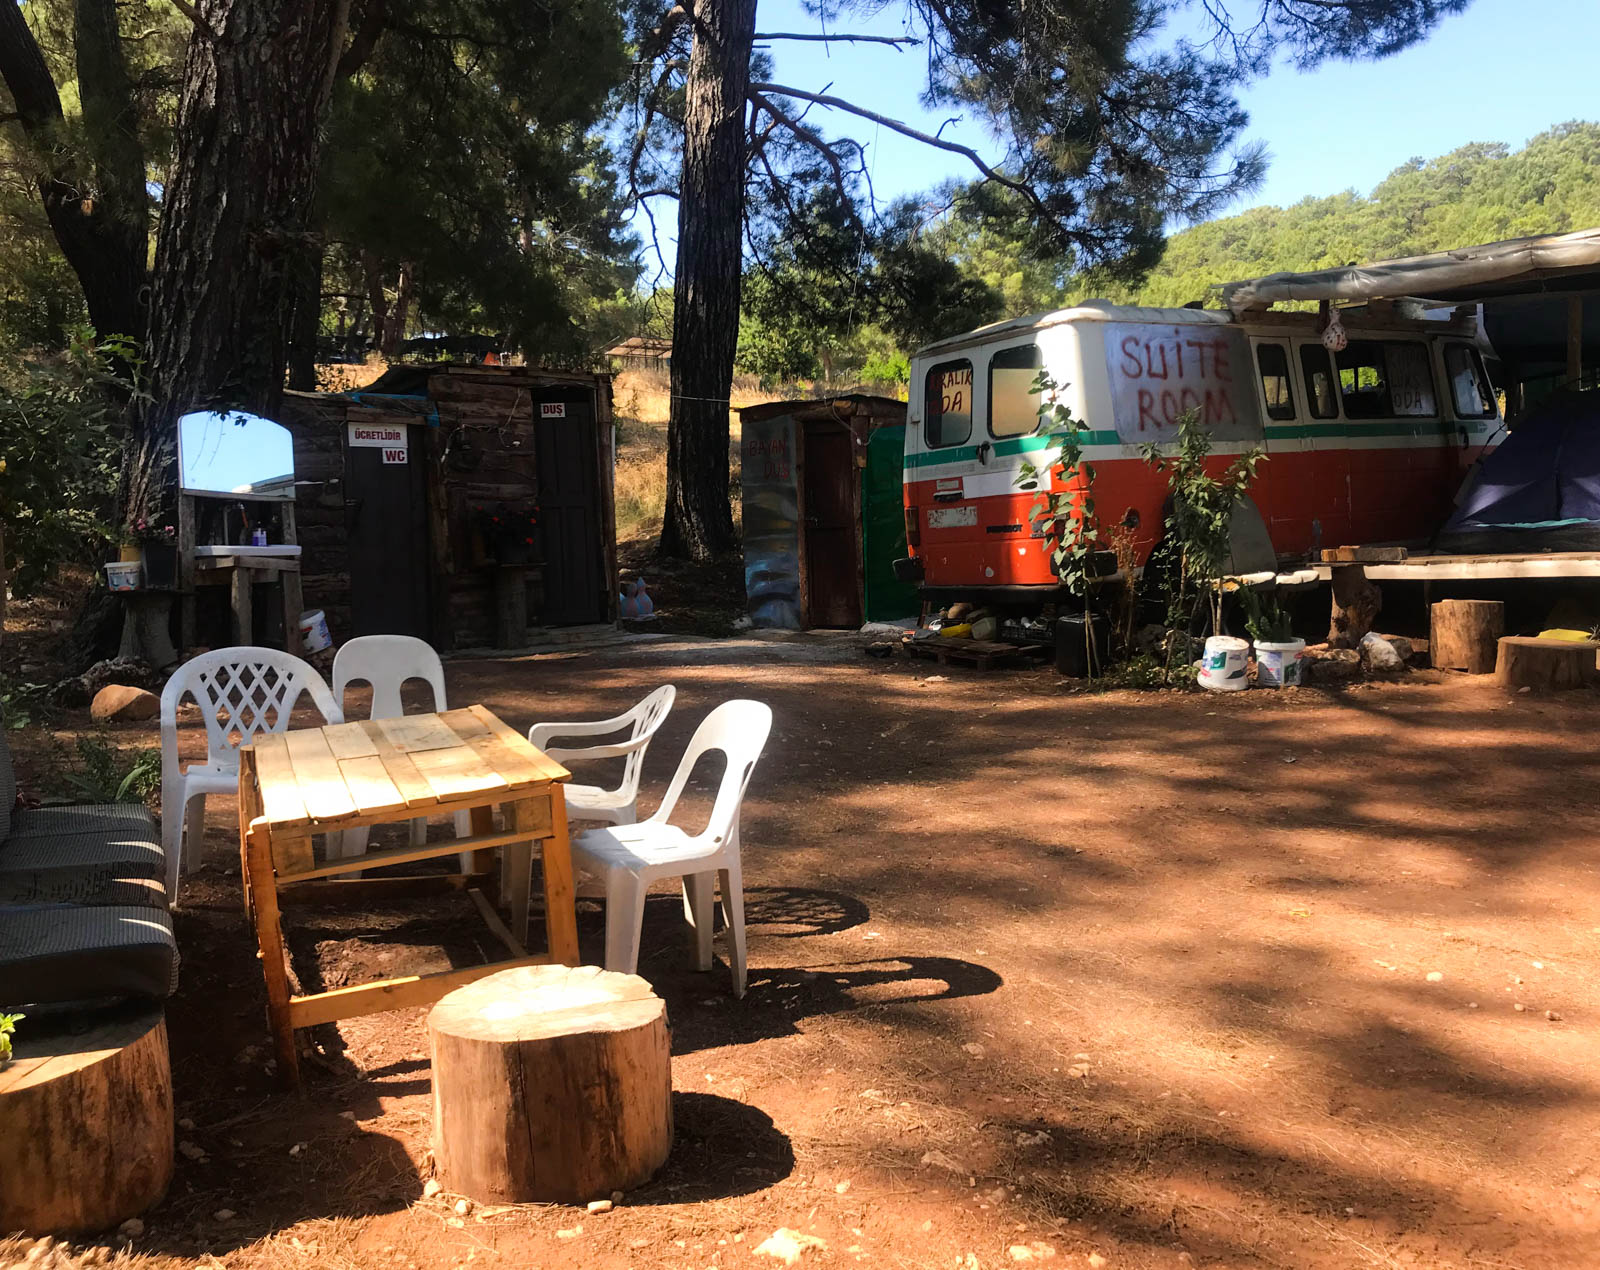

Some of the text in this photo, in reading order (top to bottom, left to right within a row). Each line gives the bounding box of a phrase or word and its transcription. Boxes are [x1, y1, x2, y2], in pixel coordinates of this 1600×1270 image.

[542, 403, 563, 417] DUŞ
[1137, 386, 1237, 431] ROOM
[354, 427, 401, 441] ÜCRETLİDİR
[385, 450, 405, 462] WC
